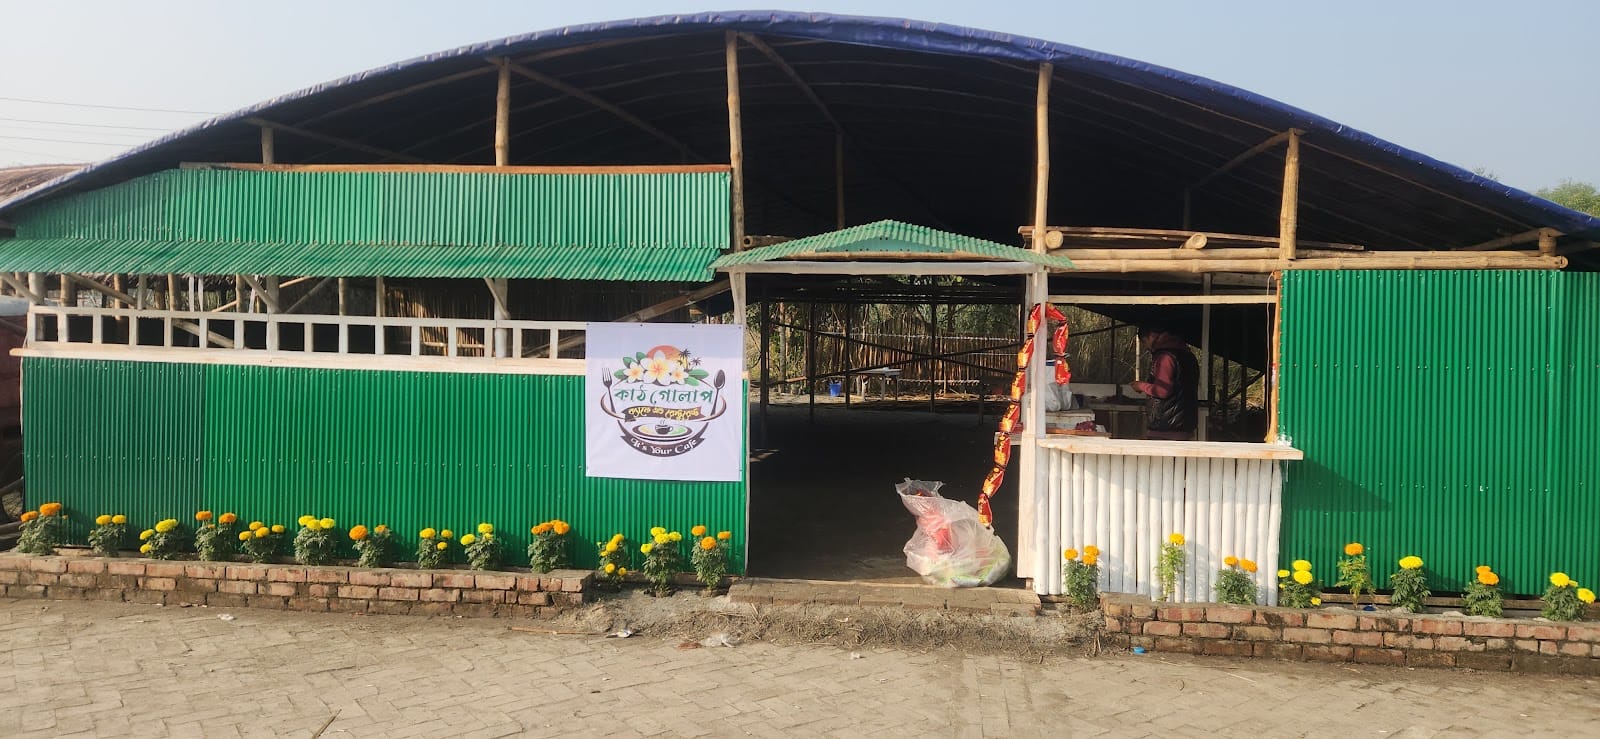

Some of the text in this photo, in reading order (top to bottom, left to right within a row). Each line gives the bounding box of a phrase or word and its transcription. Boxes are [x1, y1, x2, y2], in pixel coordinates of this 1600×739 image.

[614, 385, 714, 405] কাঠ গোলাপ
[630, 438, 697, 455] It's Your Cafe
